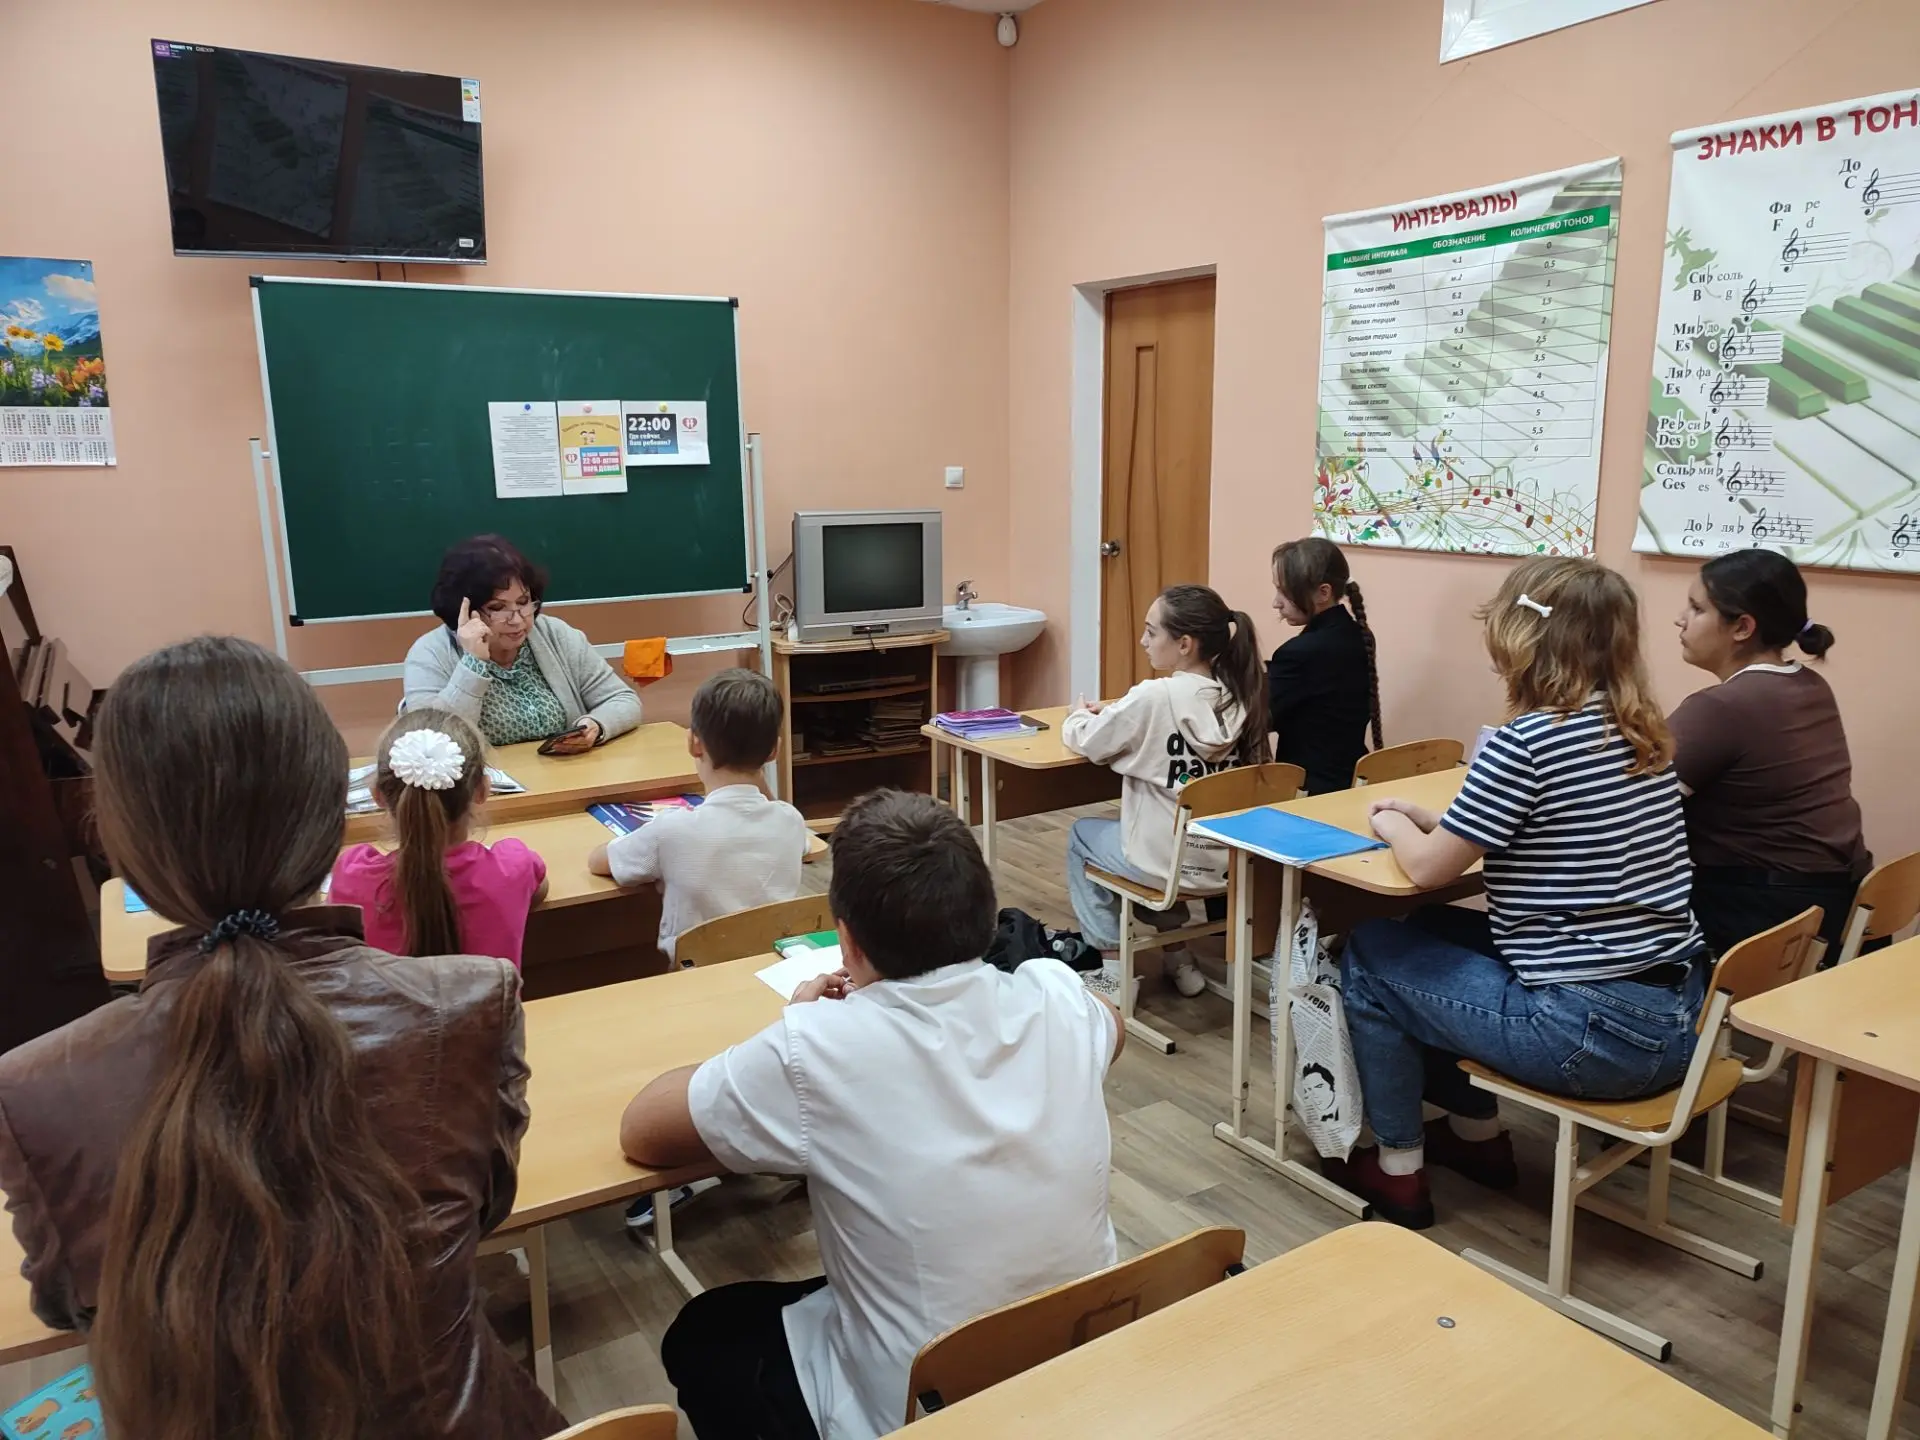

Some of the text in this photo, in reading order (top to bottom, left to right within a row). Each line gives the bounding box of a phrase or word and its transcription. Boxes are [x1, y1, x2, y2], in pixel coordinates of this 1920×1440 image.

[1697, 100, 1920, 161] ЗНАКИ В ТОН
[1838, 158, 1861, 176] До
[1844, 176, 1857, 189] C
[1392, 190, 1517, 232] ИНТЕРВАЛЫ
[1769, 200, 1820, 214] Фа ре
[1510, 215, 1594, 237] КОЛИЧЕСТВО ТОНОВ
[1773, 217, 1814, 232] F d
[1433, 233, 1486, 249] ОБОЗНАЧЕНИЕ
[1372, 248, 1408, 260] ИНТЕРВАЛА
[1717, 272, 1743, 282] соль
[1725, 290, 1733, 300] g
[1707, 324, 1719, 335] до
[1675, 340, 1691, 352] Es
[1533, 353, 1546, 362] 3,5
[1696, 367, 1711, 380] фа
[1665, 384, 1681, 395] Es
[628, 417, 671, 431] 22:00
[1658, 434, 1681, 446] Des
[1662, 478, 1710, 492] Ges es
[1681, 535, 1730, 549] Ces as
